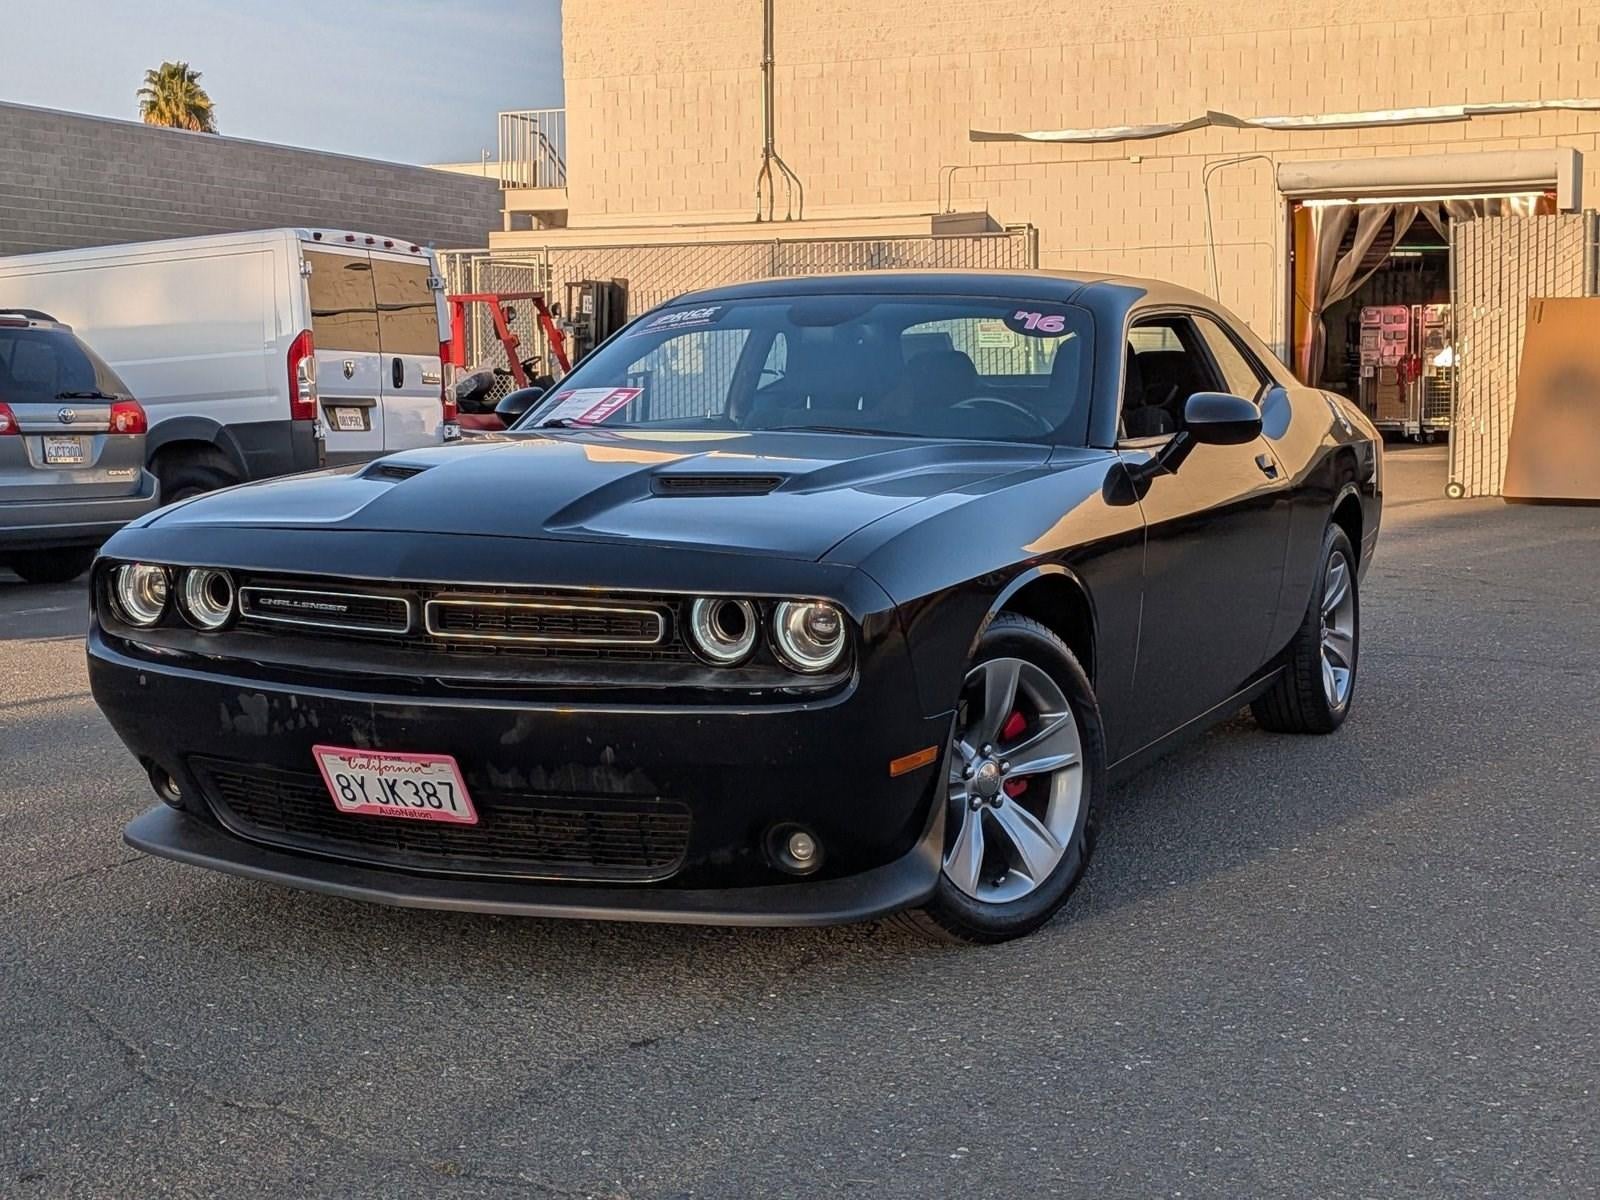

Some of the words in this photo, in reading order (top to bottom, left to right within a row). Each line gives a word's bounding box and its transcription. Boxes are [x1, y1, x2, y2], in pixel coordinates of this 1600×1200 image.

[1014, 311, 1065, 332] '16
[259, 598, 348, 612] CHALLENGER
[348, 757, 427, 776] California
[379, 807, 432, 819] AutoNation
